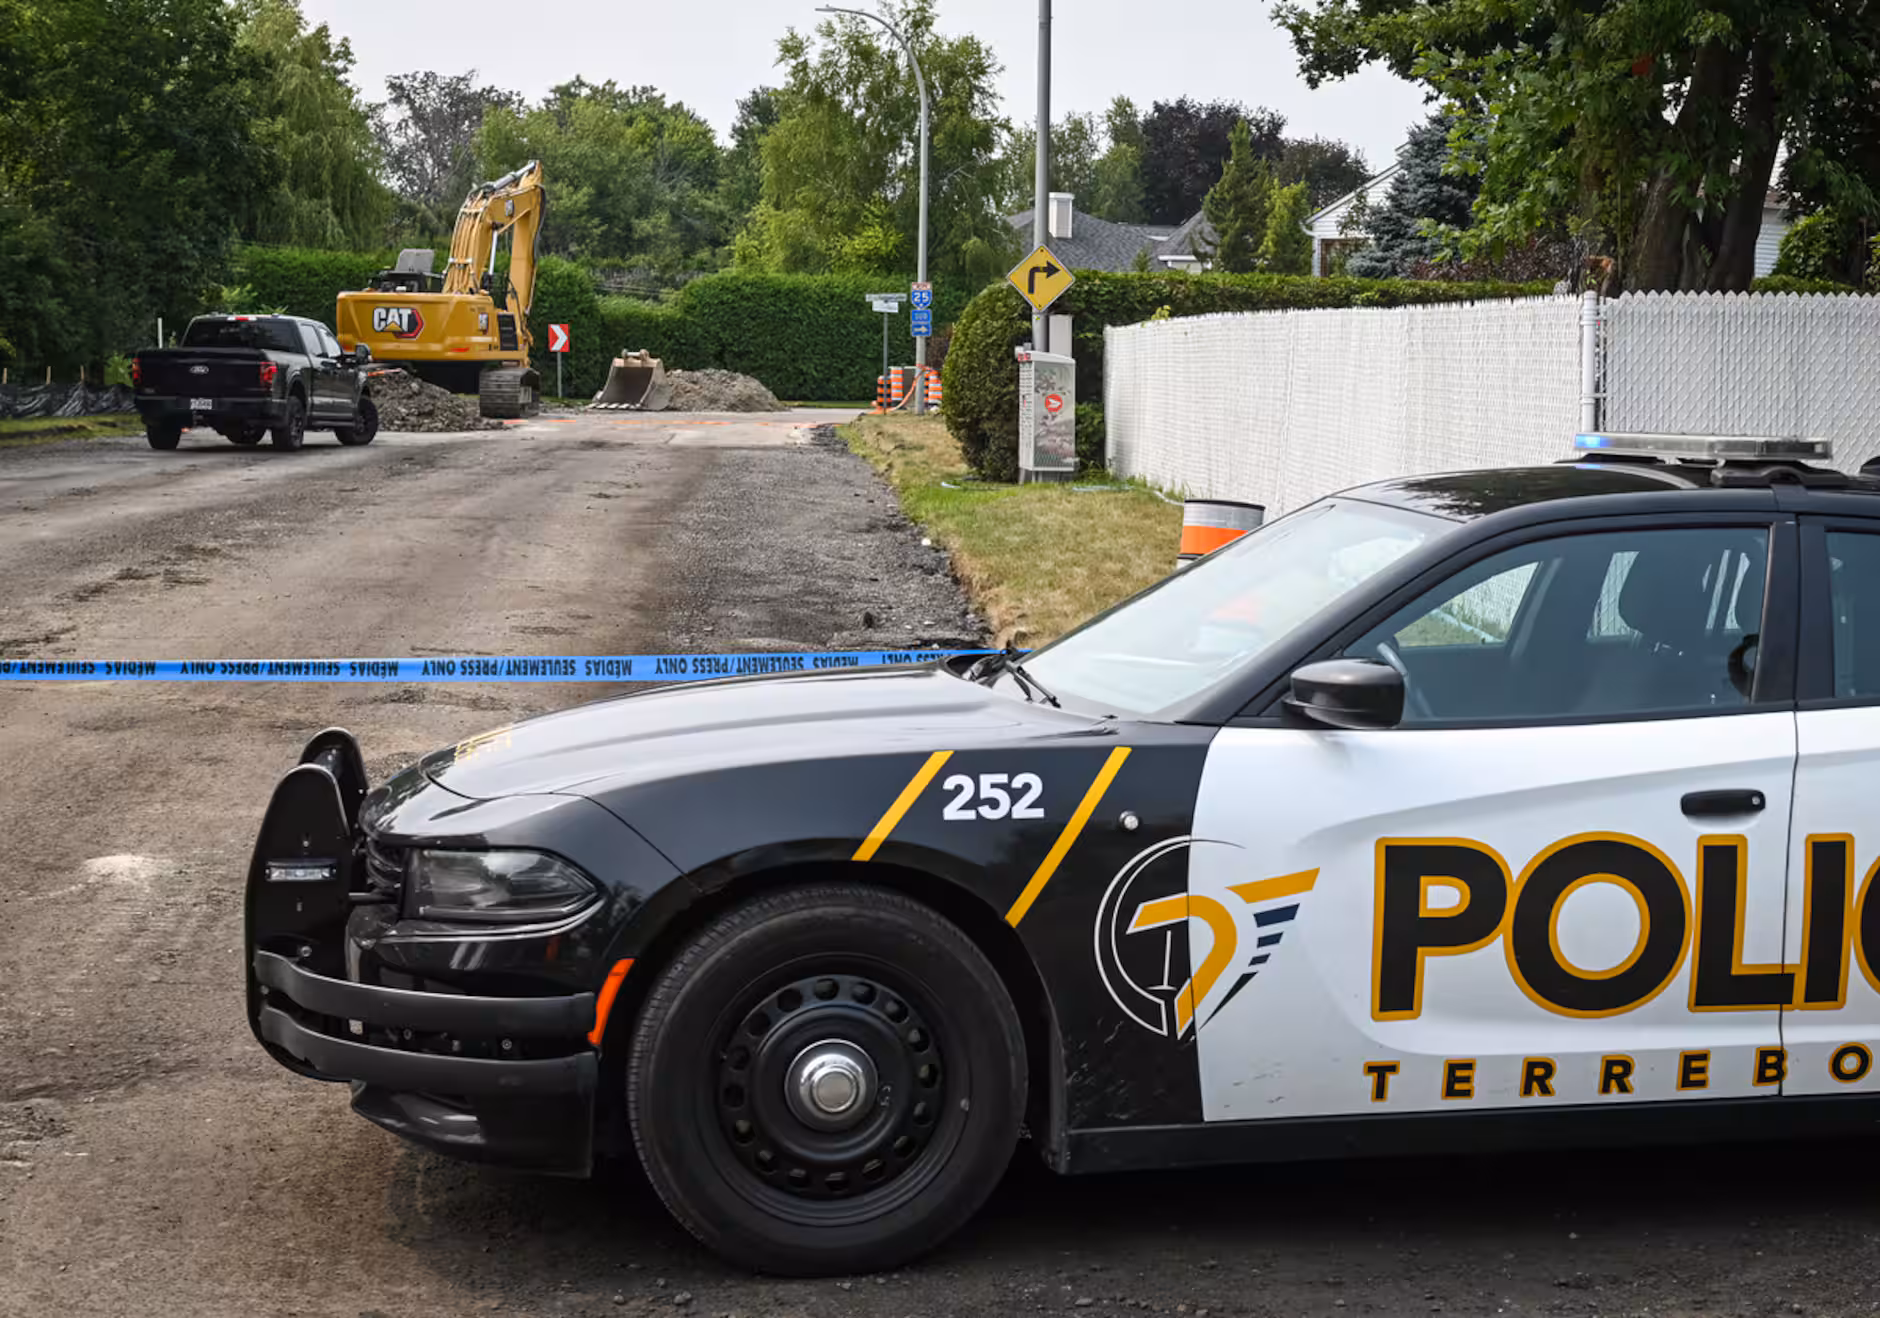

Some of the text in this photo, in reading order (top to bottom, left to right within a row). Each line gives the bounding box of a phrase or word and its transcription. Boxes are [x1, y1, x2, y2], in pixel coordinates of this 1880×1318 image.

[913, 291, 929, 303] 25
[373, 307, 413, 333] CAT
[350, 660, 399, 678] MÉDIAS
[422, 659, 456, 676] ONLY
[460, 659, 576, 676] SEULEMENT/PRESS
[585, 659, 632, 678] MÉDIAS
[655, 657, 688, 675] ONLY
[942, 772, 1045, 821] 252
[1371, 830, 1880, 1021] POLI
[1363, 1041, 1872, 1102] TERREBO
